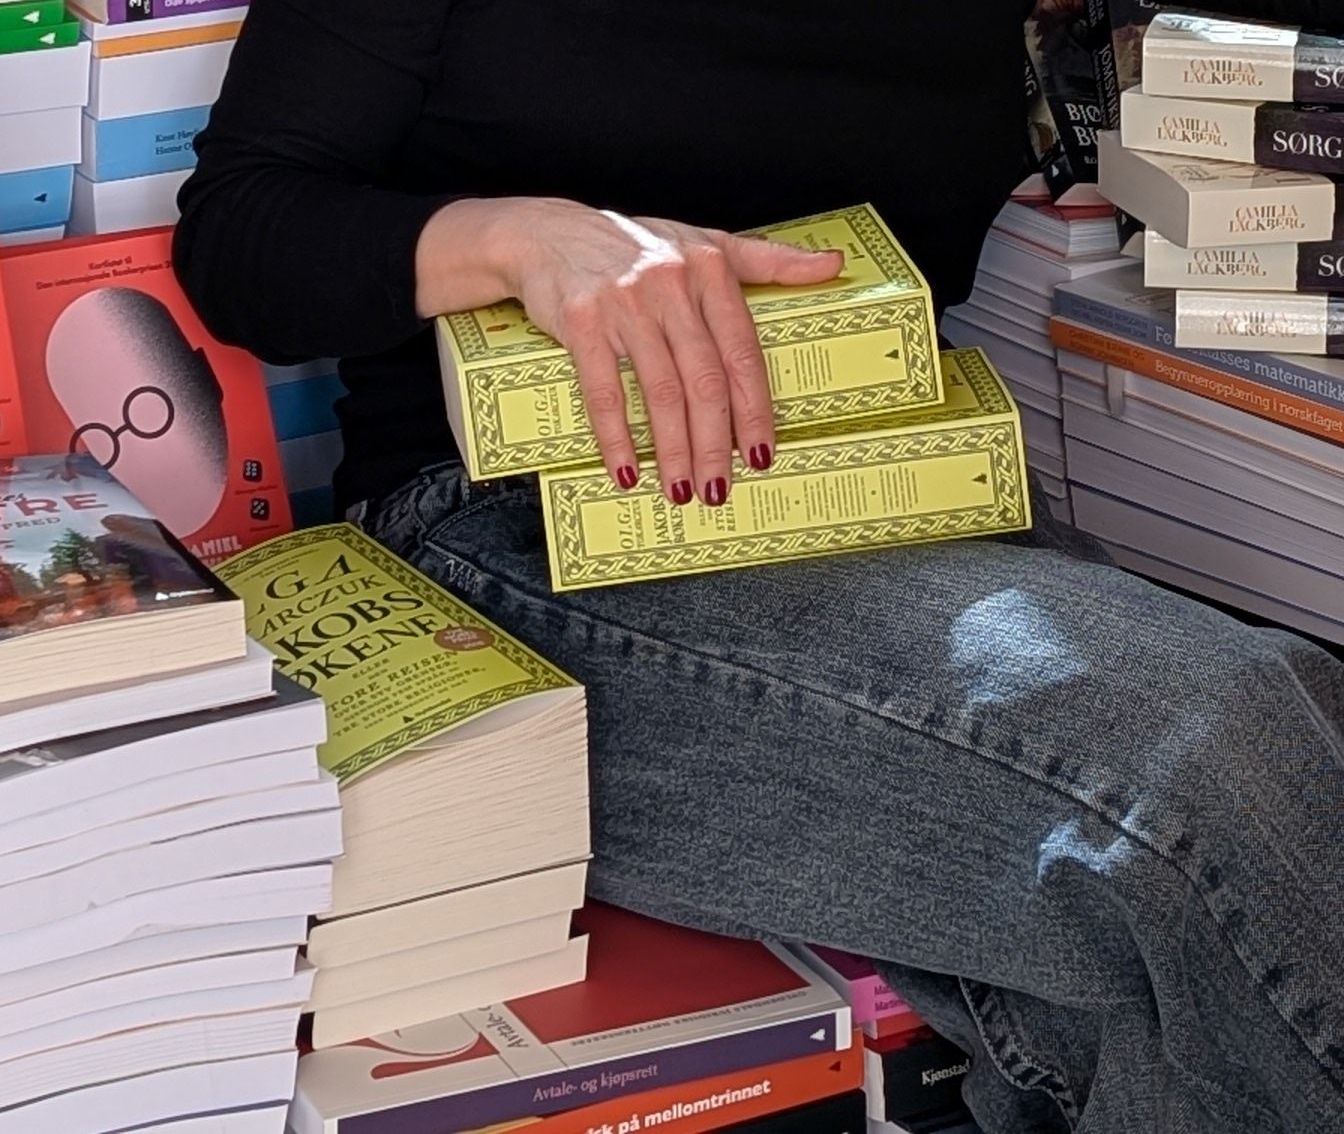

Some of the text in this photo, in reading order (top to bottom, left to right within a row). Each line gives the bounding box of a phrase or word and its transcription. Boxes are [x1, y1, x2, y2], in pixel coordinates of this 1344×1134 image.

[1190, 59, 1256, 73] CAMILLA
[1163, 116, 1221, 134] CAMILLA
[1235, 204, 1298, 220] CAMILLA
[1193, 250, 1259, 263] CAMILLA
[534, 388, 551, 436] OLGA
[1155, 359, 1343, 433] Begynneropplæring norskfaget
[3, 516, 62, 531] FRED
[618, 500, 634, 550] OLGA
[654, 494, 671, 545] JAKOBS
[265, 555, 361, 600] GA
[258, 575, 387, 639] ARCZUK
[532, 1064, 659, 1103] Avtale- og kjøpsrett
[618, 1079, 772, 1134] på mellomtrinnet
